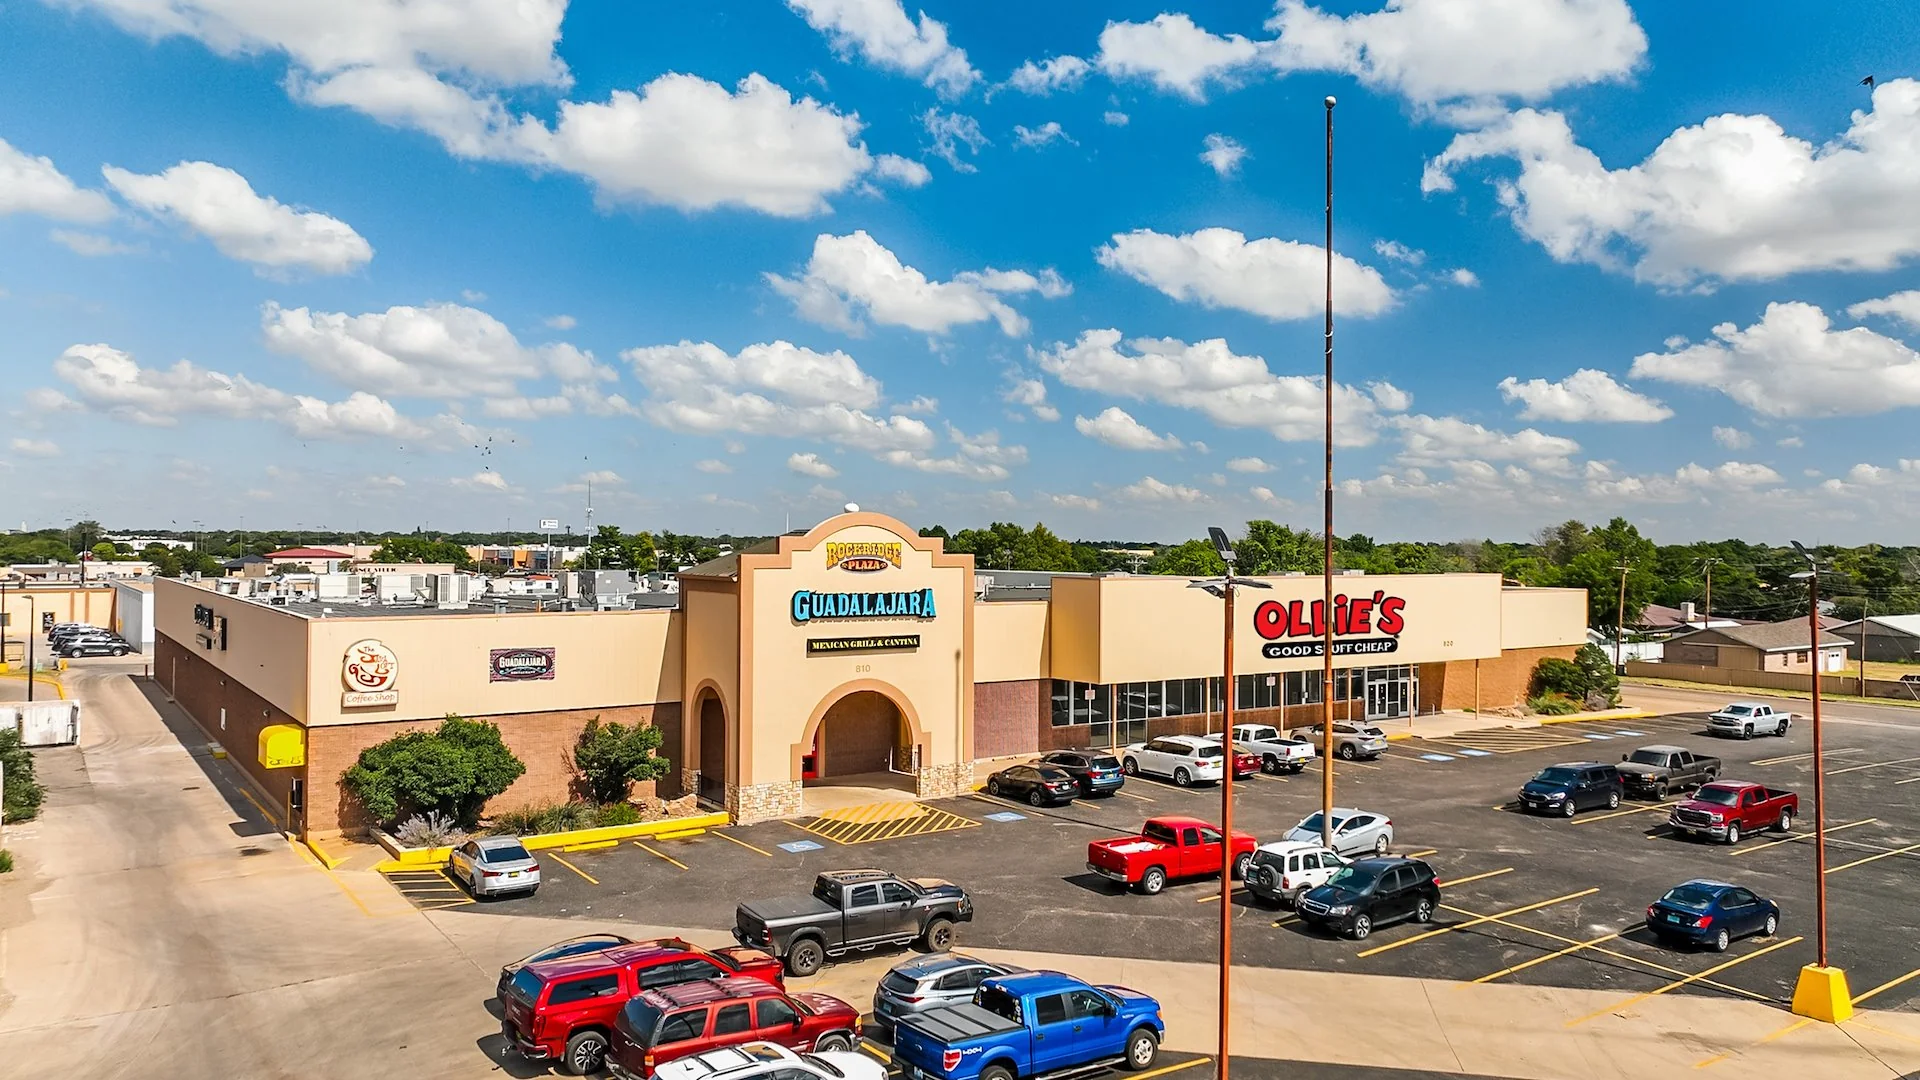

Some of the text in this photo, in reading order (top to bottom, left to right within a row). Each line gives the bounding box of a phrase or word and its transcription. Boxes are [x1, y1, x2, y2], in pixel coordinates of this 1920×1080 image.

[827, 542, 901, 570] ROCKRIDGE
[848, 561, 880, 570] PLAZA
[792, 588, 936, 621] GUADALAJARA
[812, 638, 918, 650] MEXICAN GRILL & CANTINA
[1314, 643, 1354, 655] SUFF
[499, 655, 547, 668] GUADALAJARA
[855, 664, 871, 673] 810
[346, 693, 395, 703] Coffee Shop
